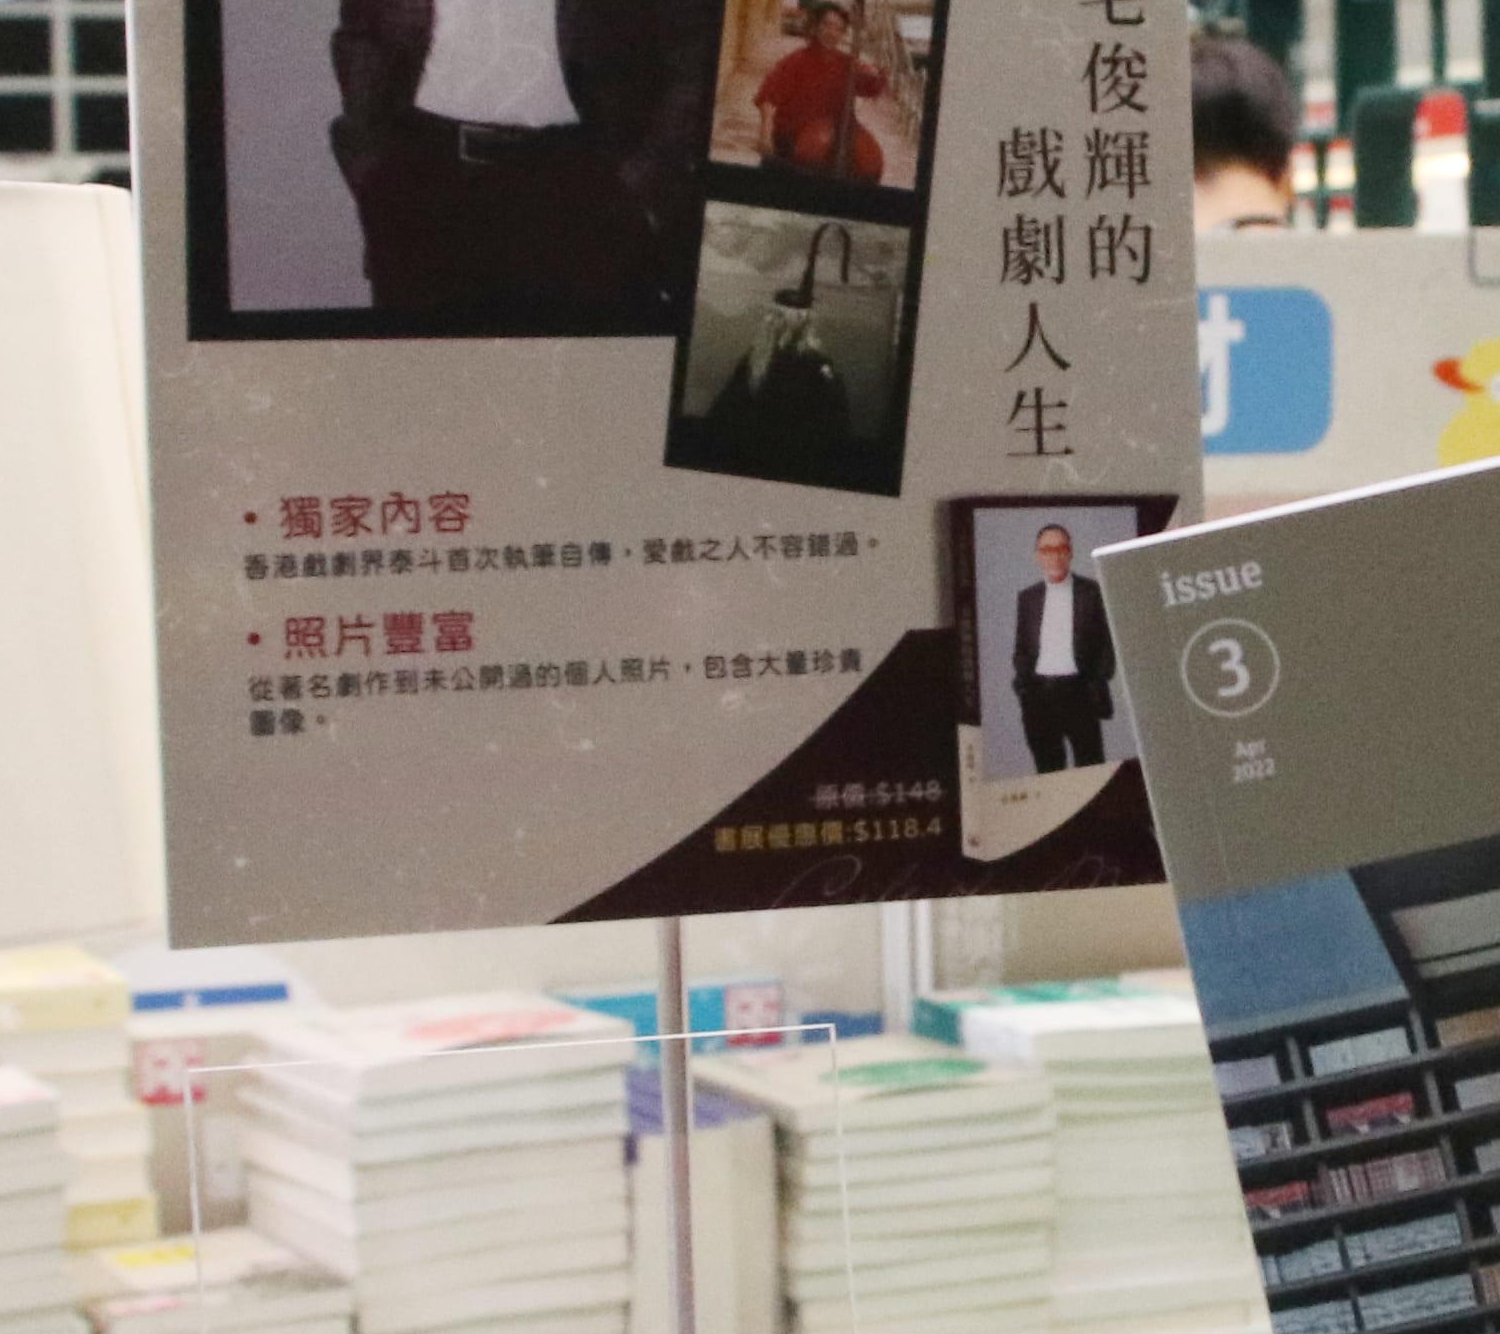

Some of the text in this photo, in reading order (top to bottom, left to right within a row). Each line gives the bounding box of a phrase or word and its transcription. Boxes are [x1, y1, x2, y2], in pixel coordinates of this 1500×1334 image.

[997, 125, 1076, 458] 戲劇人生
[277, 489, 473, 540] 獨家內容
[1160, 558, 1264, 608] issue
[283, 609, 477, 659] 照片豐富
[1208, 637, 1252, 698] 3
[1232, 757, 1276, 784] 2022
